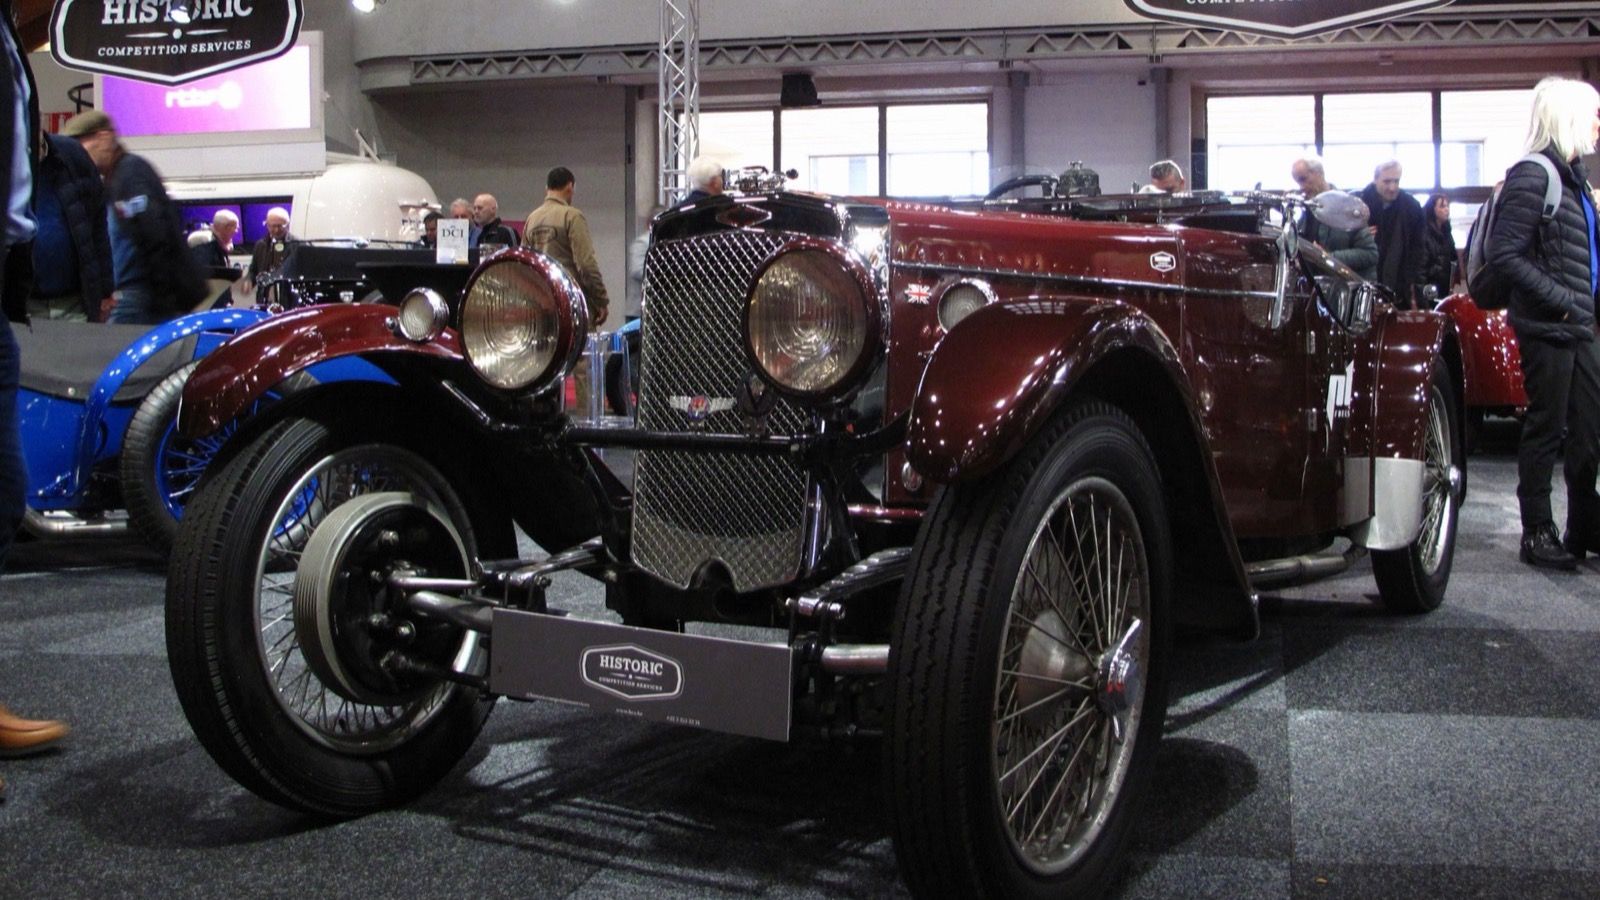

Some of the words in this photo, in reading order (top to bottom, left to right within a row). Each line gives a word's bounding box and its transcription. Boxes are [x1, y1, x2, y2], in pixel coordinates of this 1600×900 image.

[101, 0, 254, 25] HISTRIC
[98, 44, 188, 57] COMPETITION
[190, 40, 252, 54] SERVICES
[442, 228, 464, 238] DCI
[600, 655, 663, 675] HISTORIC
